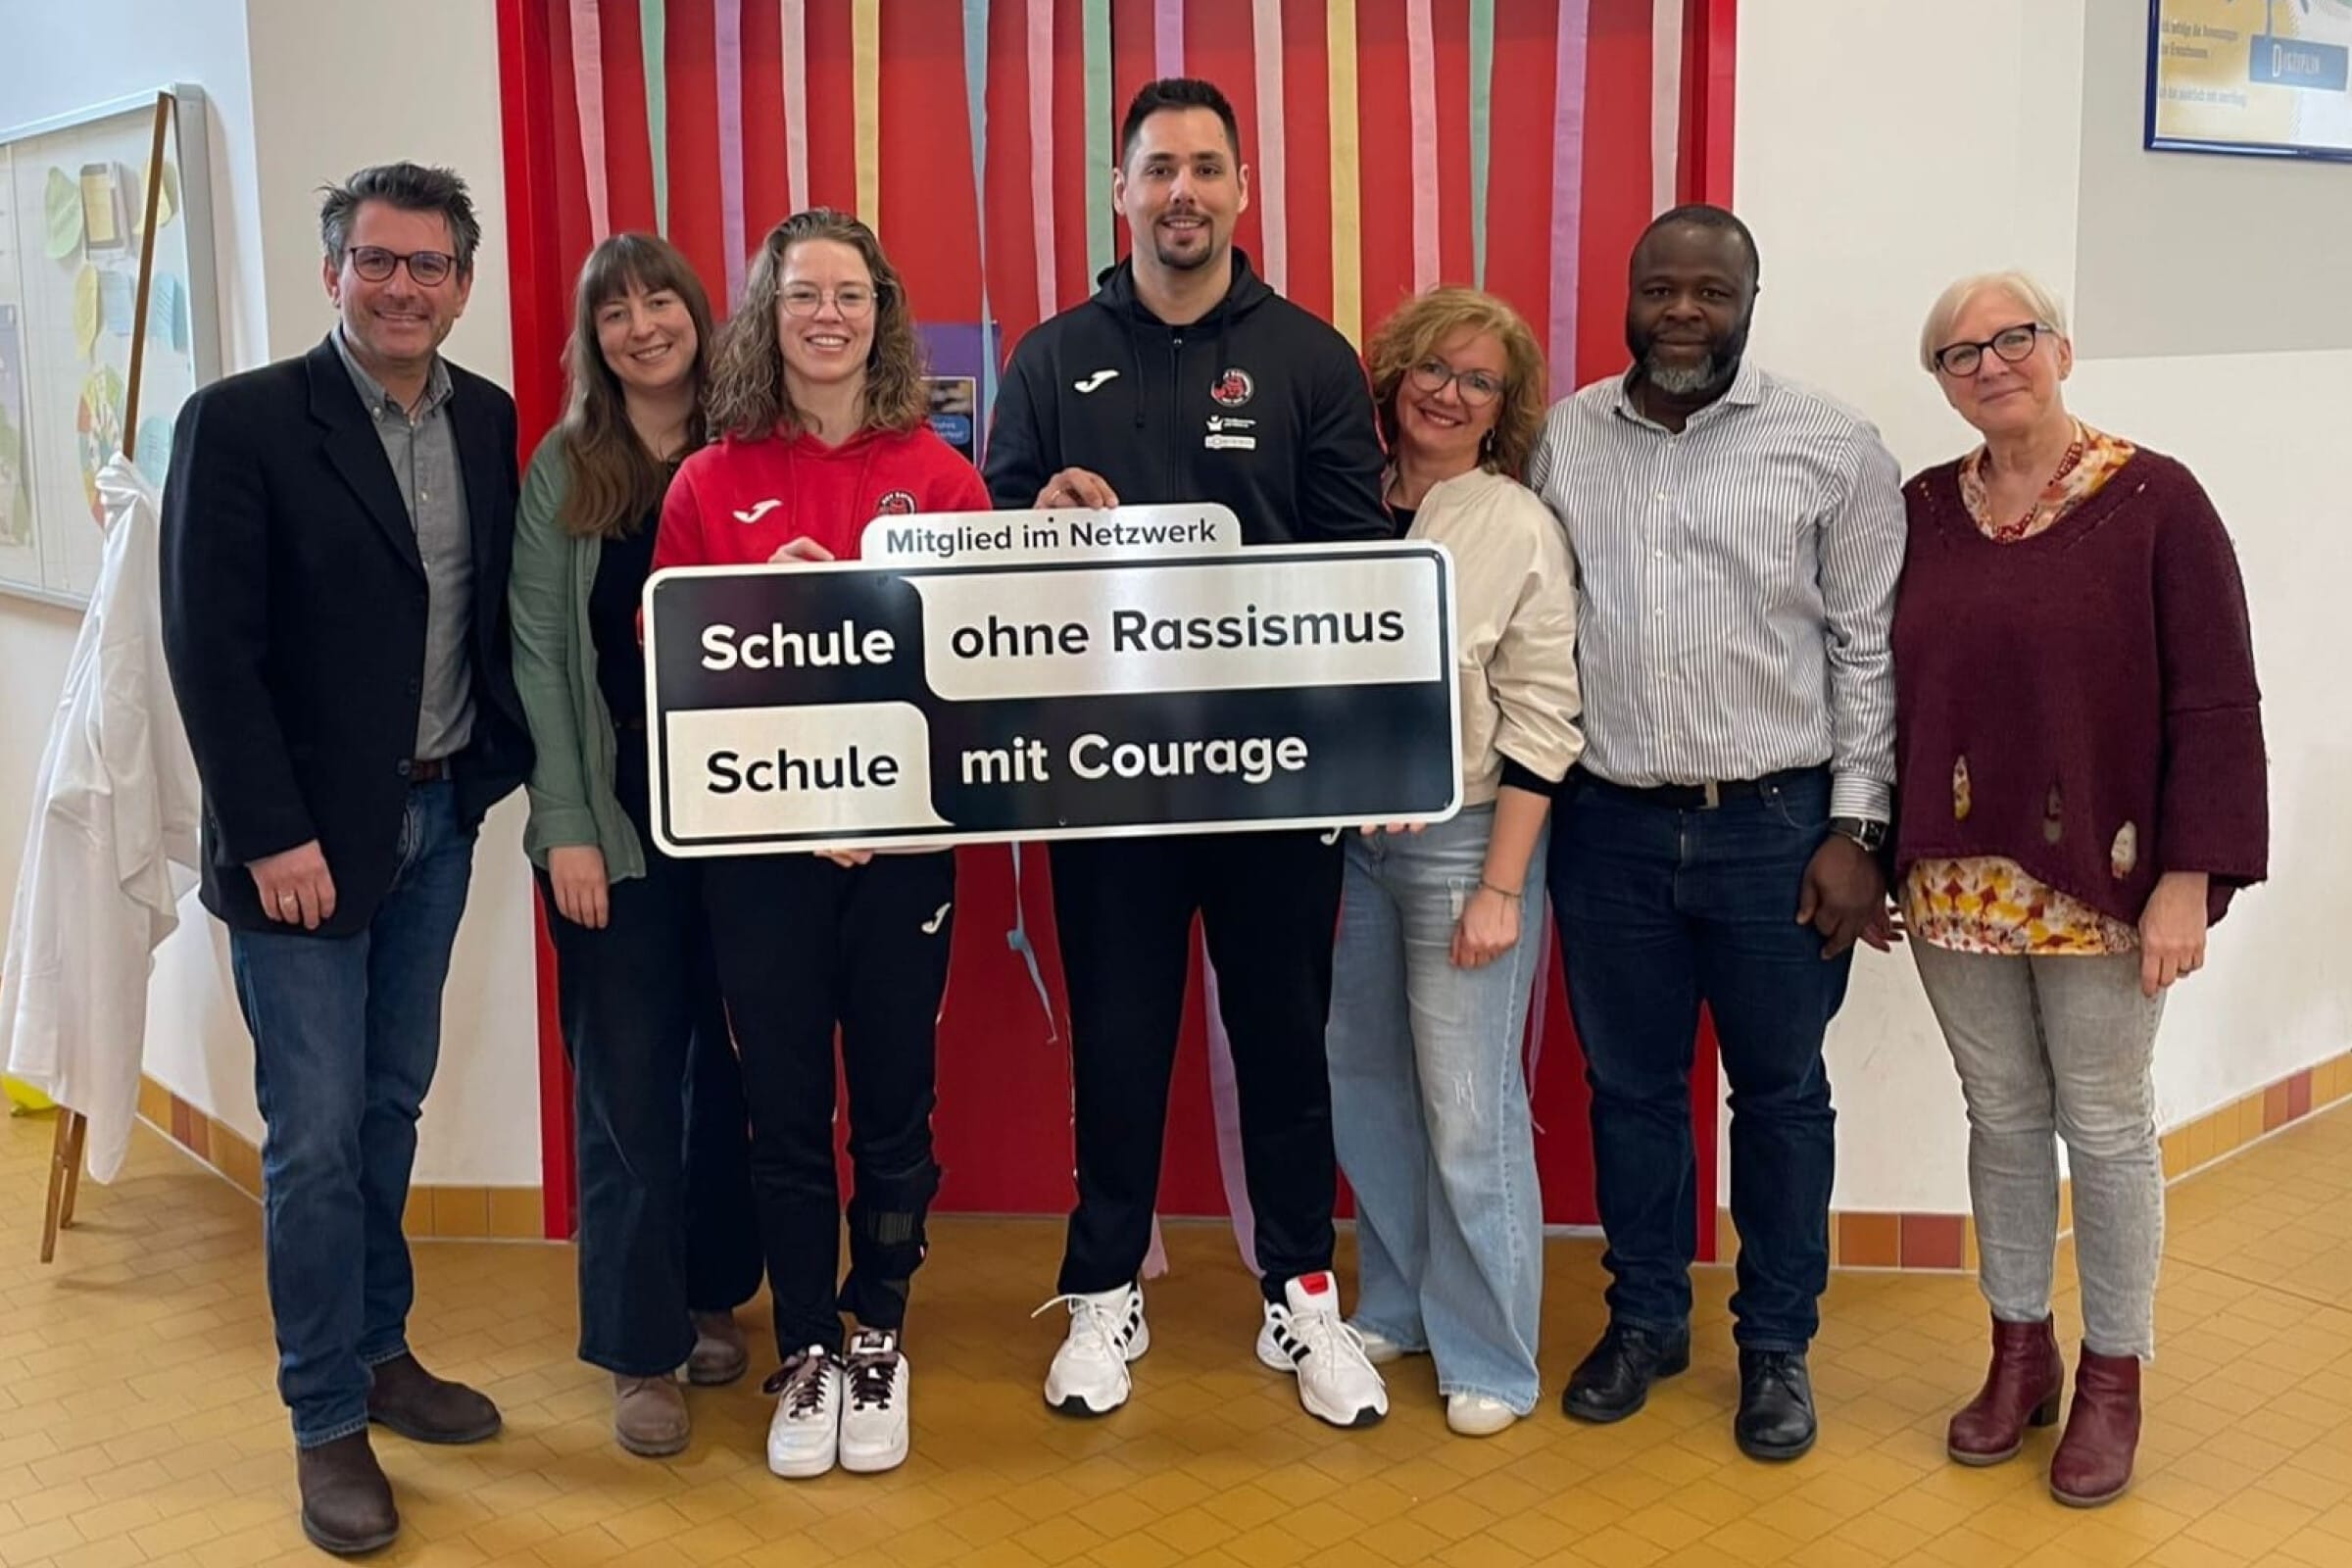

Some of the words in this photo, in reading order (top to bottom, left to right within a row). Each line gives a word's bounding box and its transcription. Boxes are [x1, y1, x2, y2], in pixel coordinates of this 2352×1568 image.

[887, 523, 1012, 558] Mitglied
[1022, 524, 1059, 549] im
[1069, 518, 1217, 548] Netzwerk
[700, 618, 896, 670] Schule
[952, 613, 1090, 660] ohne
[1111, 603, 1405, 653] Rassismus
[706, 745, 900, 795] Schule
[961, 734, 1050, 785] mit
[1068, 732, 1308, 785] Courage
